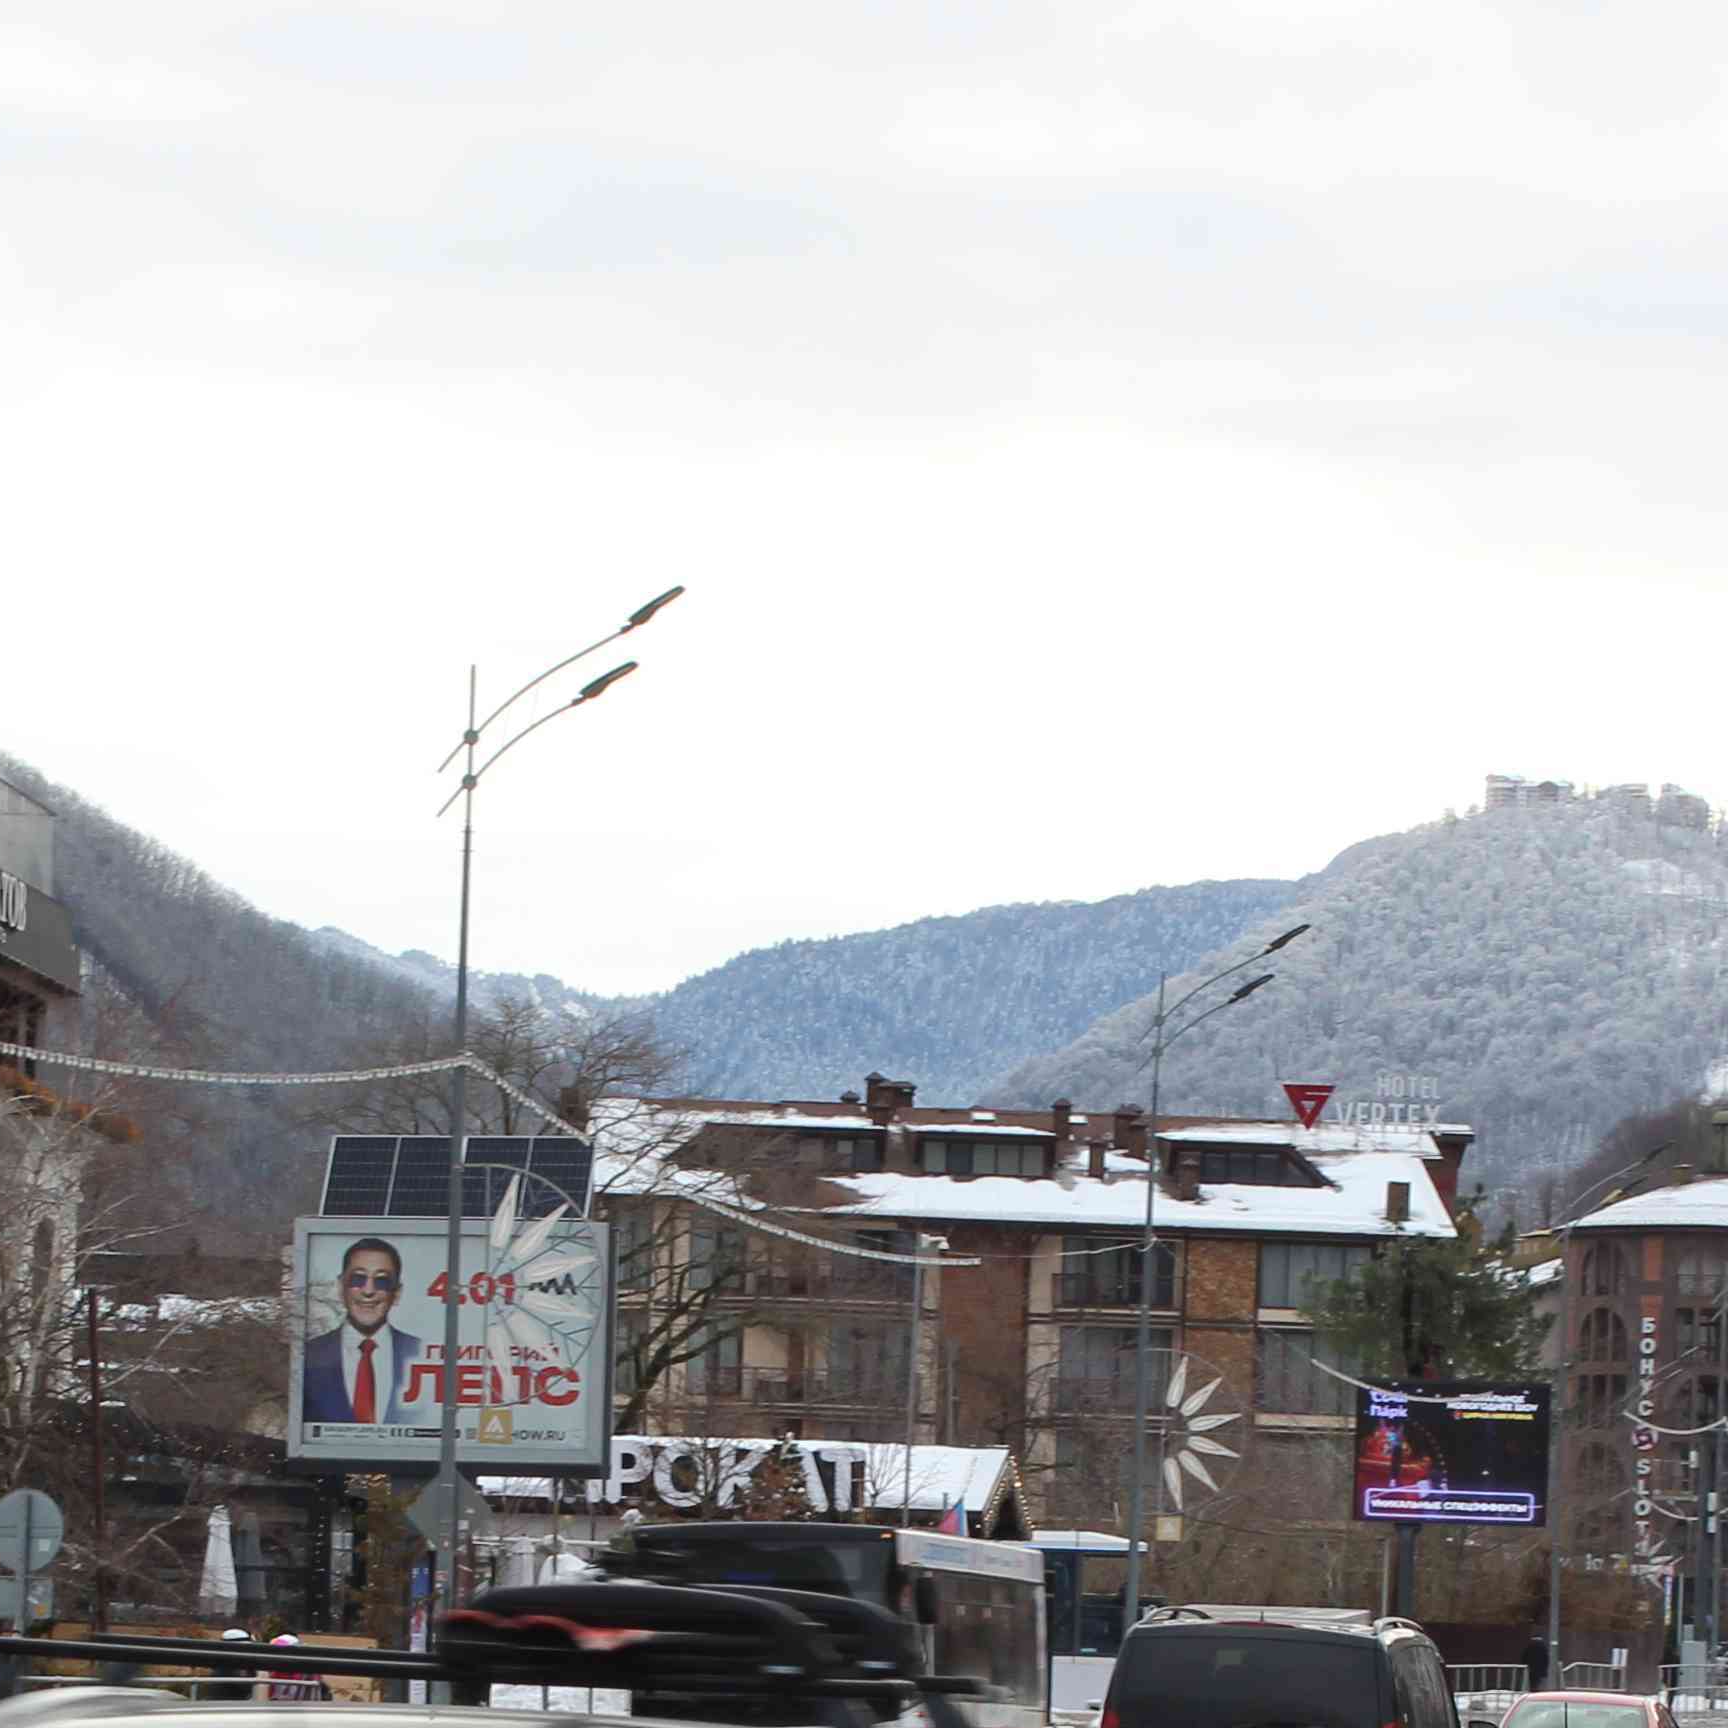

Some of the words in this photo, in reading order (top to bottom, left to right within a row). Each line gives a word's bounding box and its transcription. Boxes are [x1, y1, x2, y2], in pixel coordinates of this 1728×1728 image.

[1376, 1074, 1440, 1099] HOTEL
[1336, 1102, 1441, 1129] VERTEX
[1640, 1317, 1656, 1417] БОНУС
[558, 1436, 866, 1513] РОКАТ
